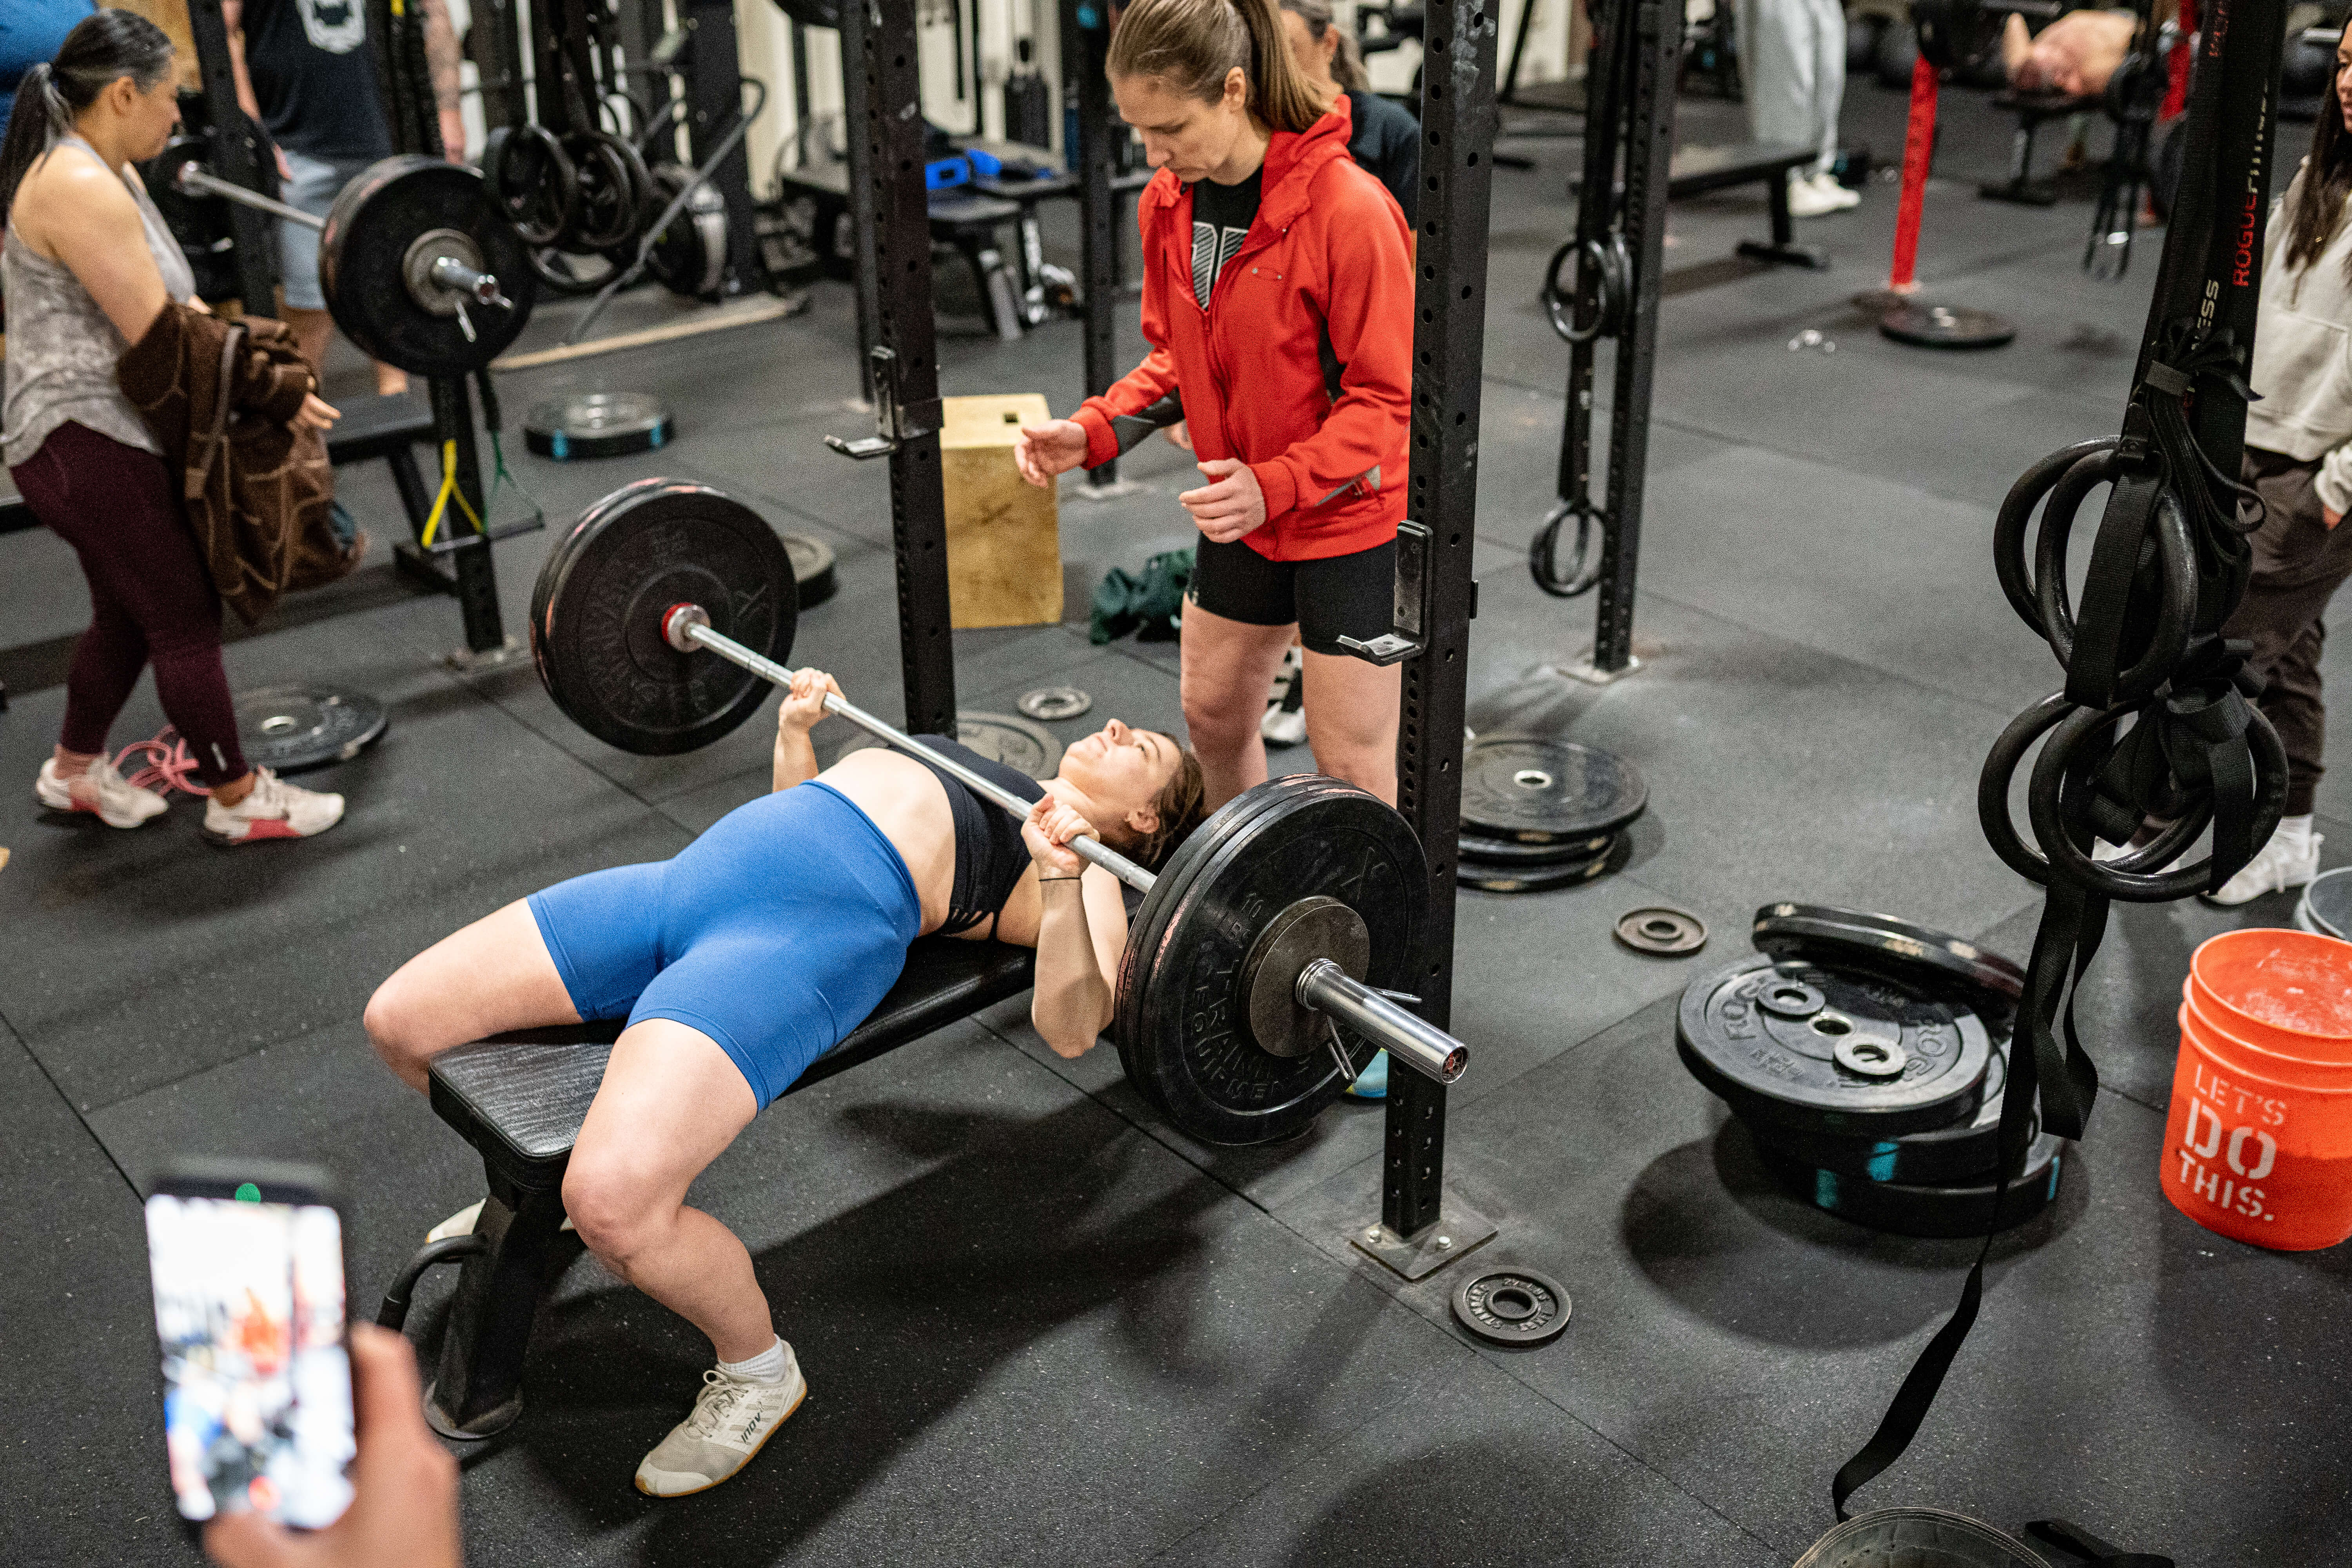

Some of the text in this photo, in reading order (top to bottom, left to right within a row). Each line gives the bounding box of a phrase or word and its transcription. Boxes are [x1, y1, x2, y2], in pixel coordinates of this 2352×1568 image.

[2194, 1063, 2287, 1127] LET'S
[2183, 1097, 2277, 1181] DO
[2179, 1149, 2274, 1221] THIS.
